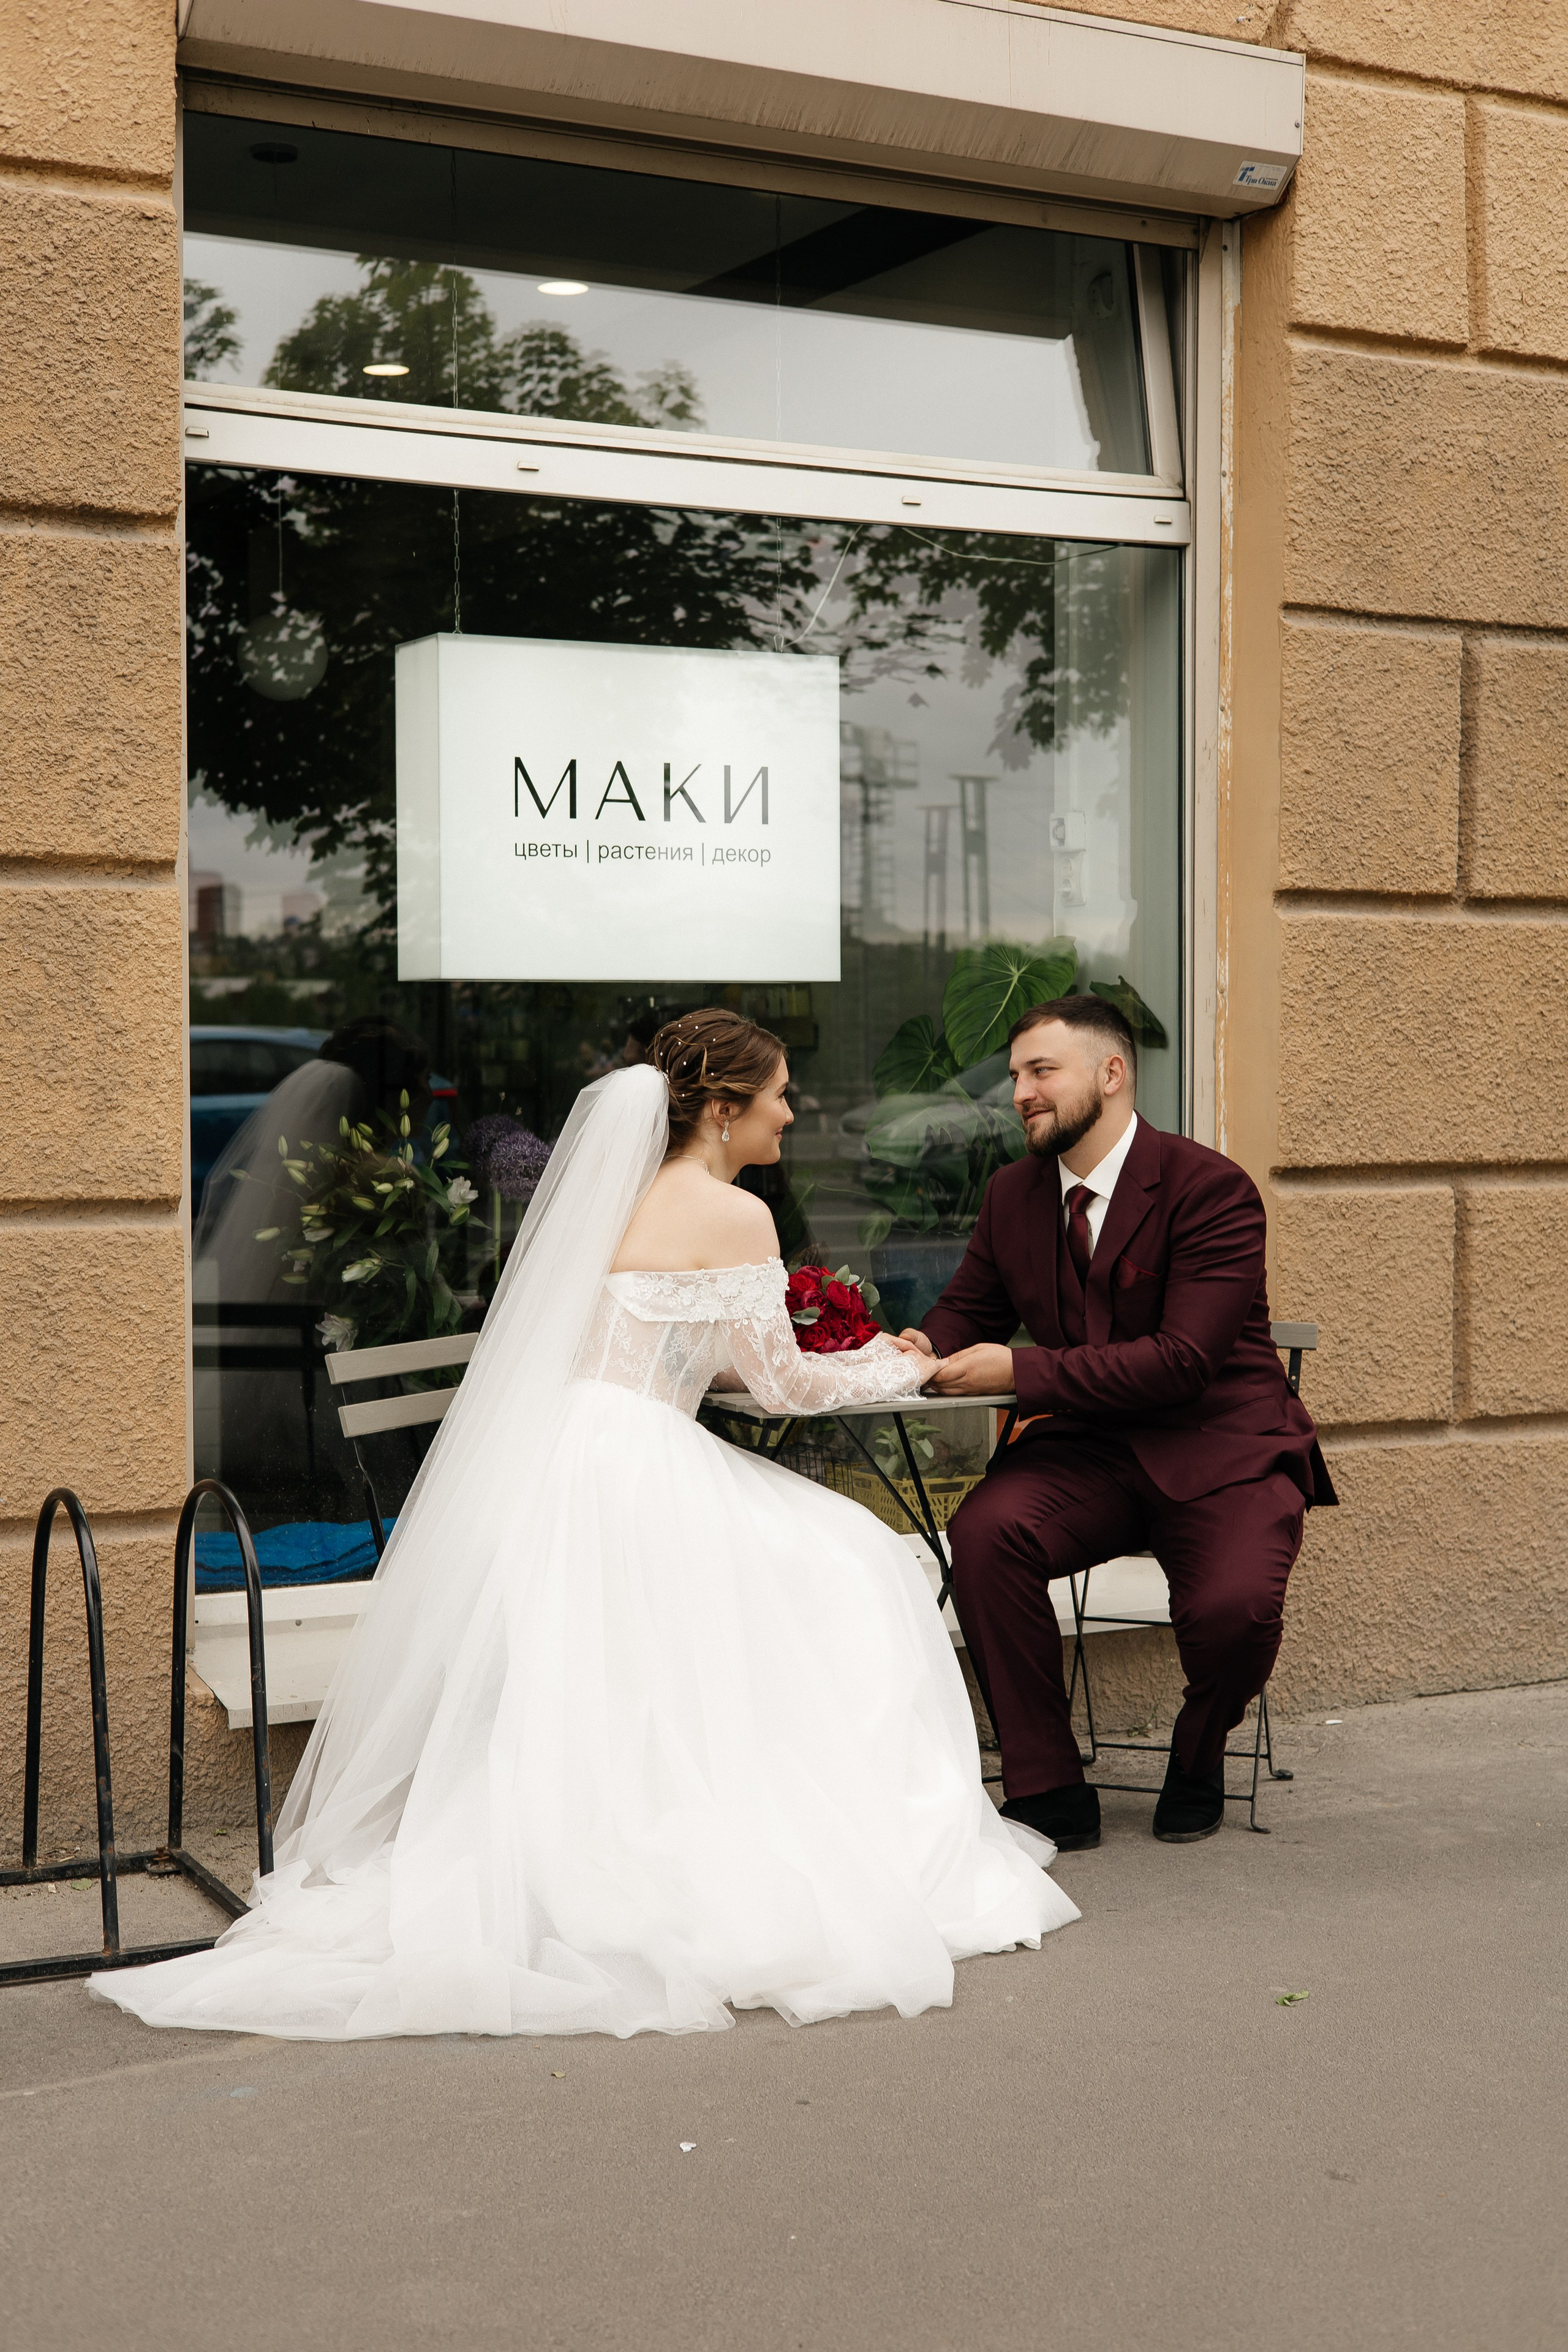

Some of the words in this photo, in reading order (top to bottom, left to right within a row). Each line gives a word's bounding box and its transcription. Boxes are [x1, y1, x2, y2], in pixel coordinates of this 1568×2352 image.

[1245, 175, 1257, 185] Три
[1258, 177, 1277, 186] Окна
[514, 756, 769, 825] МАКИ
[514, 842, 578, 860] цветы
[598, 844, 693, 863] растения
[712, 847, 771, 867] декор
